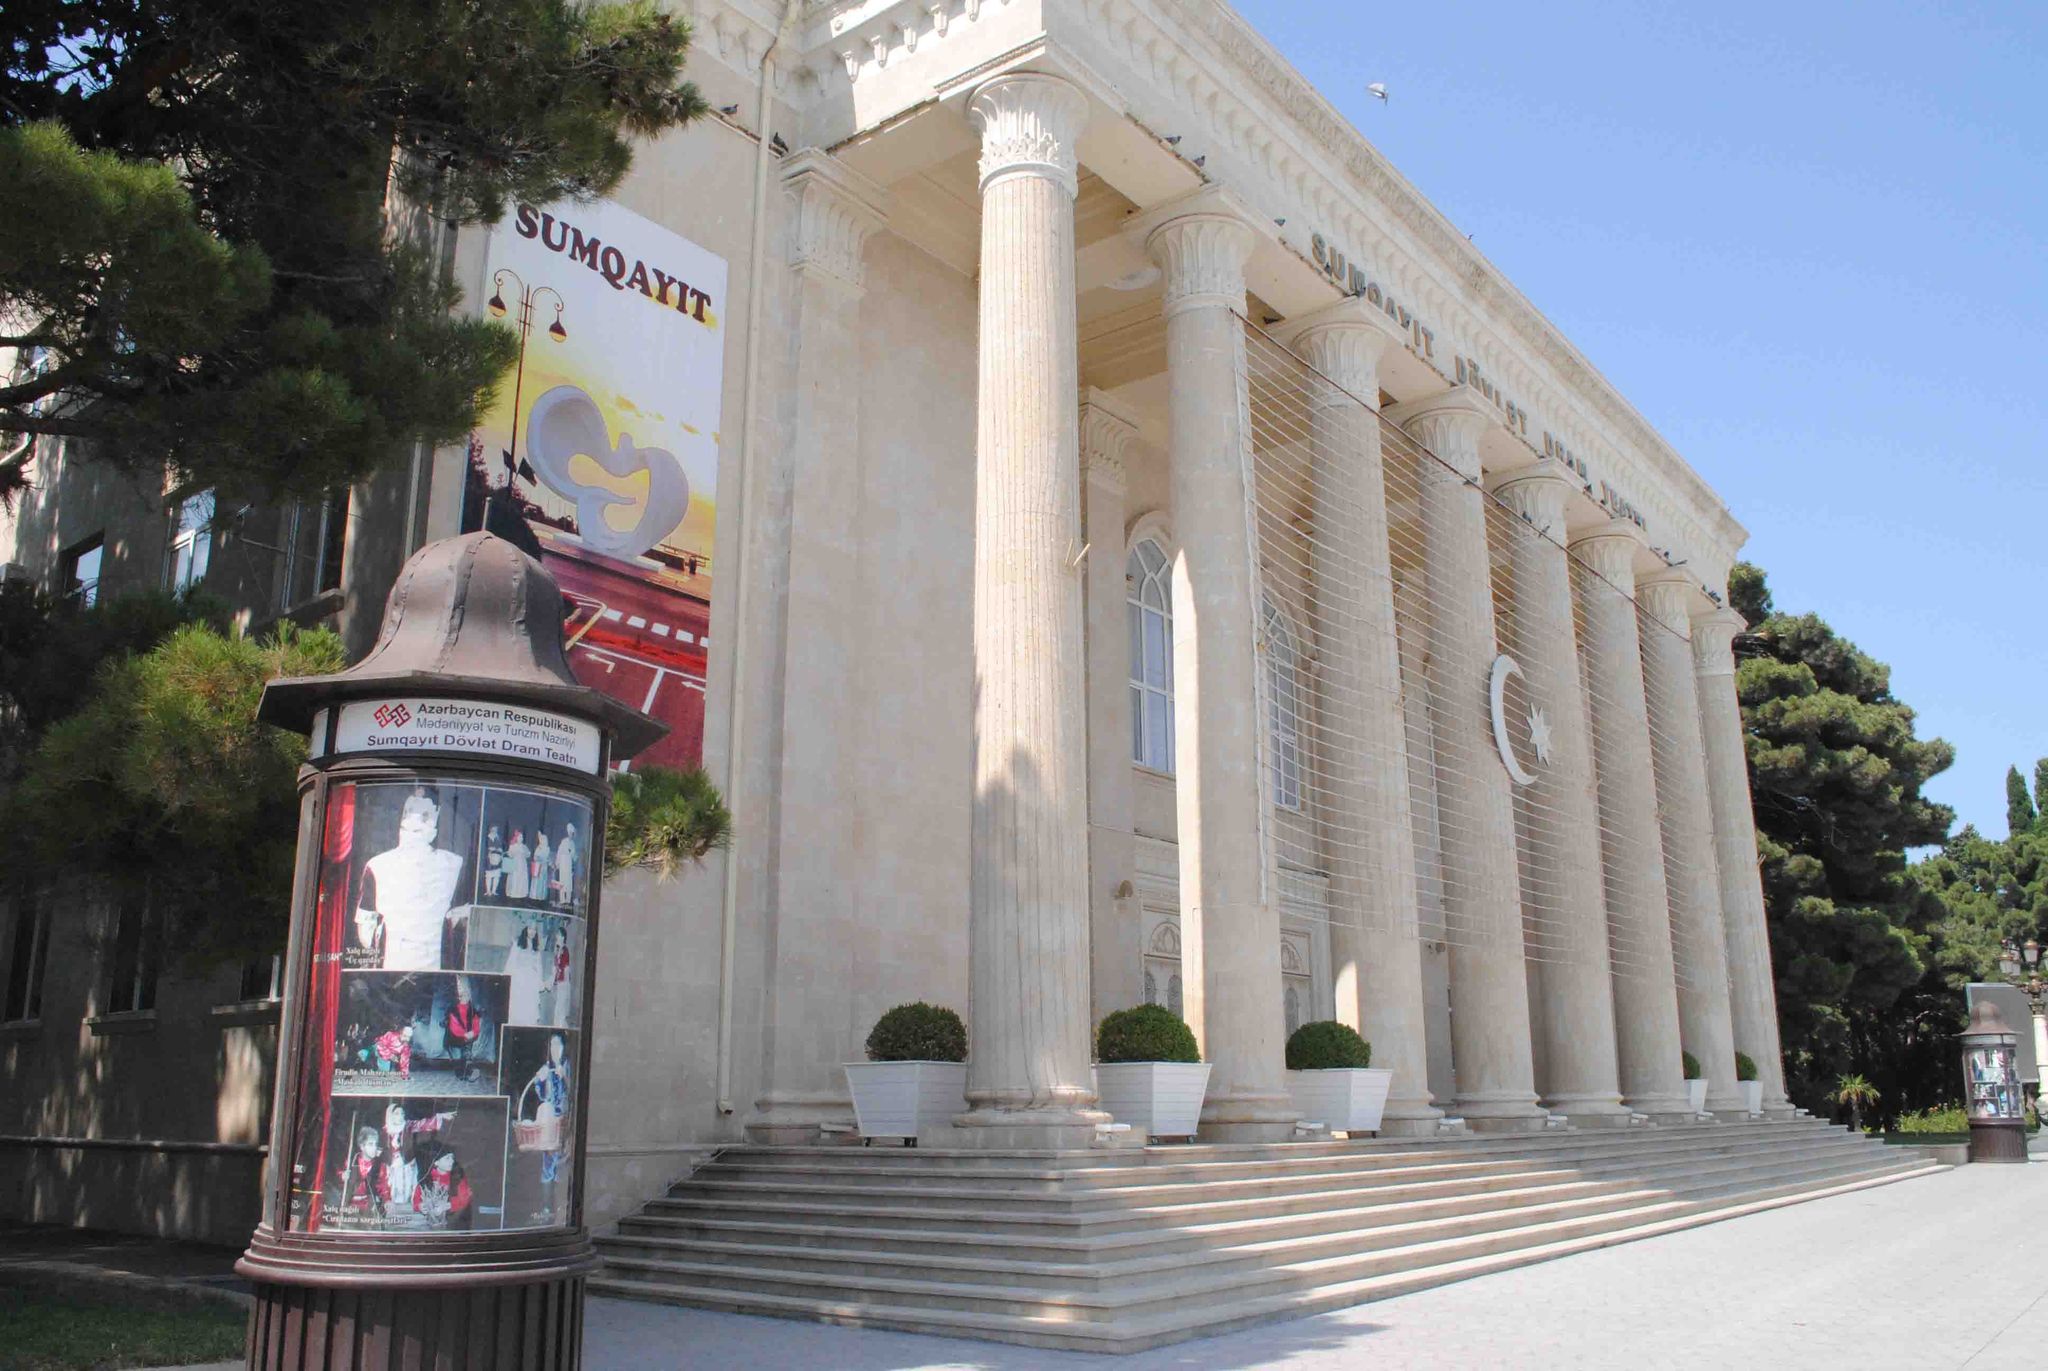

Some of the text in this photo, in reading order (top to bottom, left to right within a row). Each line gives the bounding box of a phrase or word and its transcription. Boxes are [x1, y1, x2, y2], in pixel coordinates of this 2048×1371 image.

[515, 203, 712, 323] SUMQAYIT
[416, 717, 483, 733] Mədəniyyət
[487, 723, 501, 733] və
[417, 703, 577, 735] Azərbaycan Respublikası
[367, 734, 577, 765] Sumqayıt Dövlət Dram Teatrı
